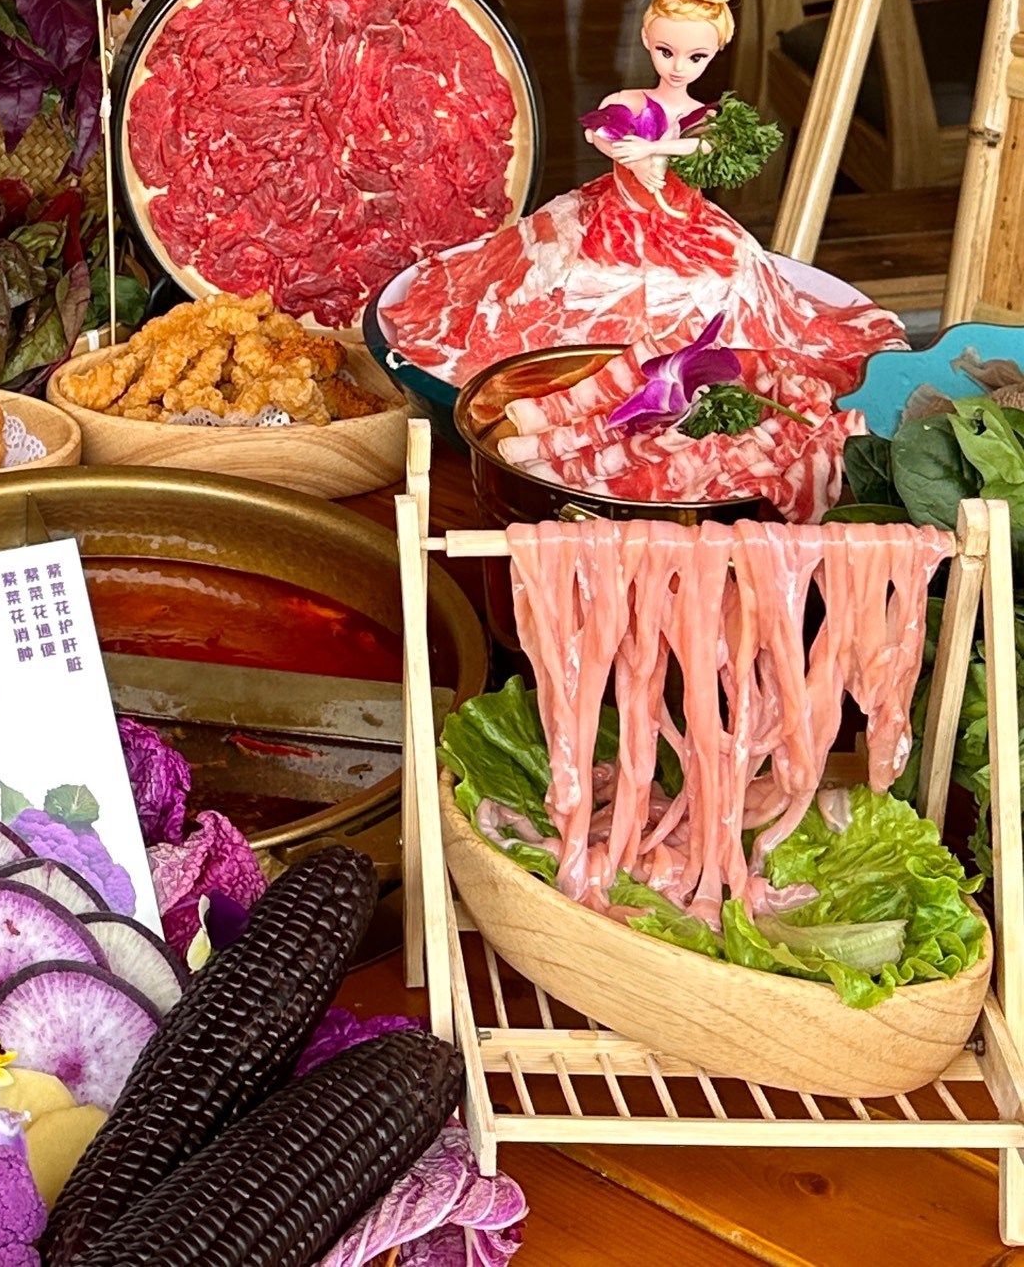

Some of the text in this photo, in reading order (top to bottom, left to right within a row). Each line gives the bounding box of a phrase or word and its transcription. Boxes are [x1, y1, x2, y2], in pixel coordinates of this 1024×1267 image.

[1, 571, 33, 662] 紫菜花消肿
[23, 567, 56, 658] 紫菜花通便
[46, 563, 83, 673] 紫菜花护肝脏
